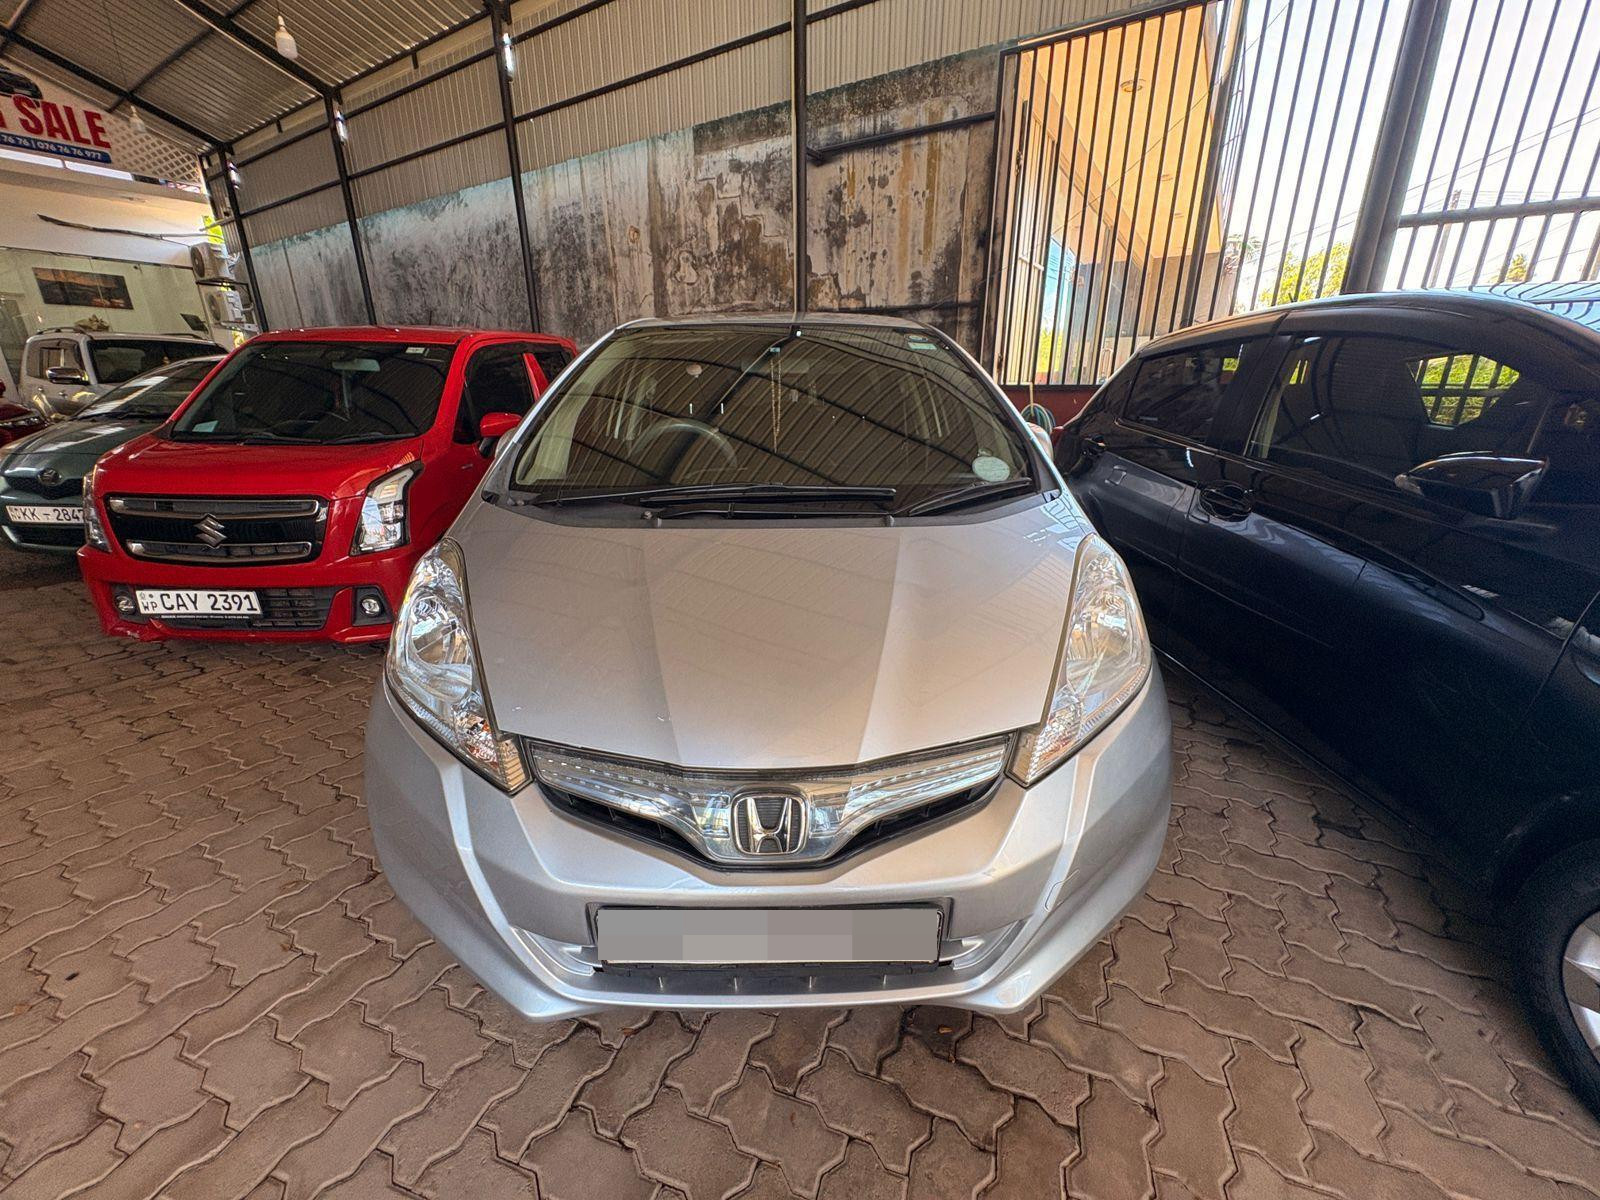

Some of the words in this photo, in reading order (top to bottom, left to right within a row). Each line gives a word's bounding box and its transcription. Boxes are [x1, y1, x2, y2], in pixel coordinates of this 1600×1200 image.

[12, 93, 112, 149] SALE
[20, 508, 41, 521] KK
[141, 601, 158, 612] WP
[160, 593, 199, 611] CAY
[207, 593, 258, 612] 2391
